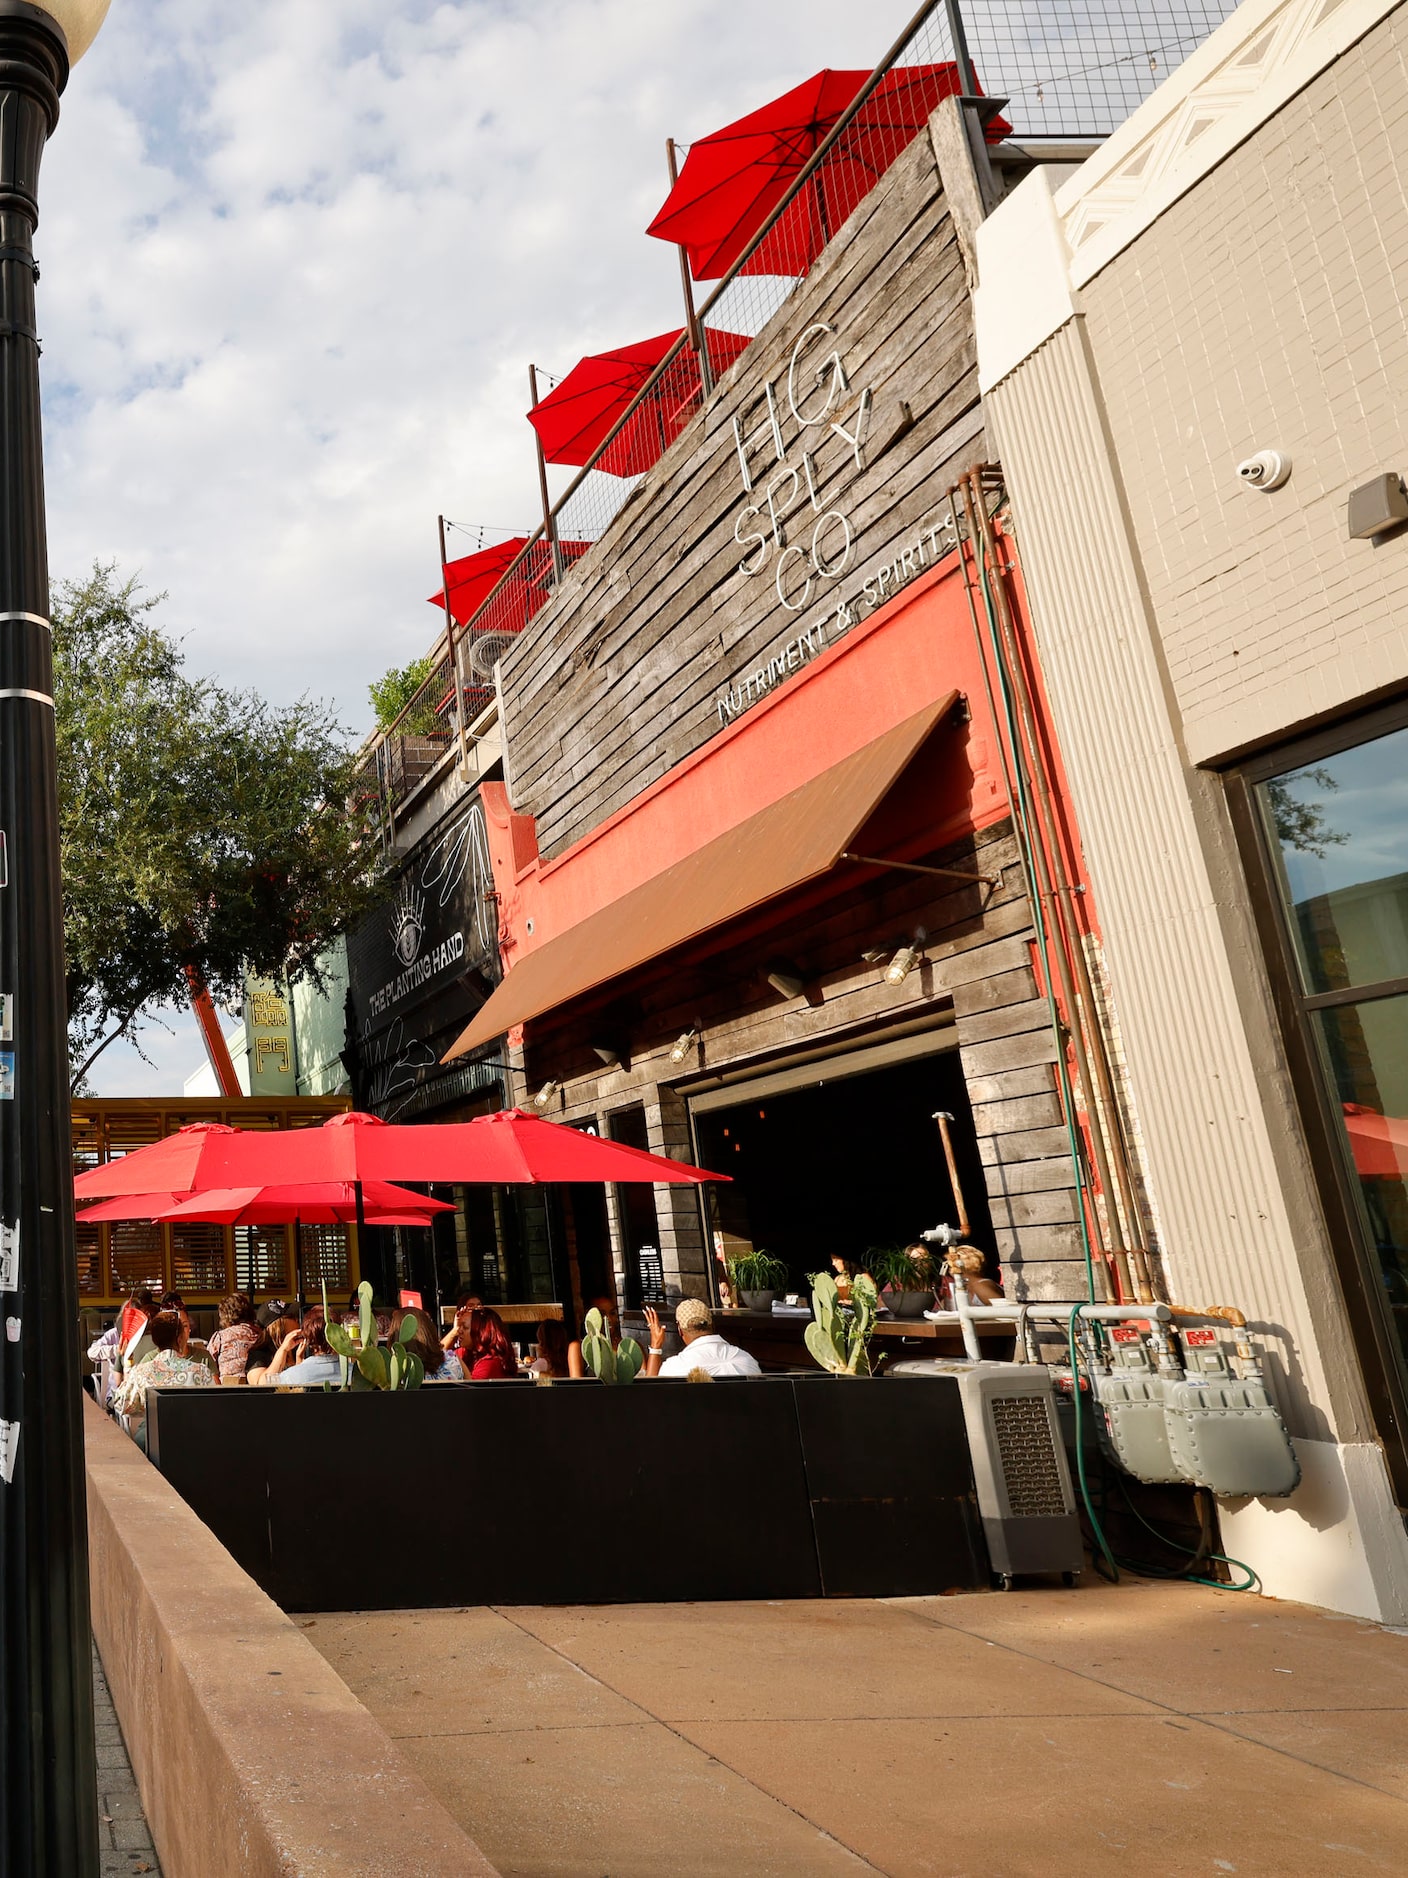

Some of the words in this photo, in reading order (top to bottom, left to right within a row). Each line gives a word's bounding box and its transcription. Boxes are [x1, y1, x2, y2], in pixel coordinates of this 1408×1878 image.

[733, 322, 850, 491] HG
[734, 387, 873, 576] SPLY
[717, 616, 829, 721] NUTRIMENT
[836, 602, 852, 630] &
[863, 512, 962, 606] SPIRITS
[776, 511, 851, 610] CO
[369, 988, 386, 1017] THE
[385, 954, 432, 1008] PLANTING
[432, 931, 464, 974] HAND
